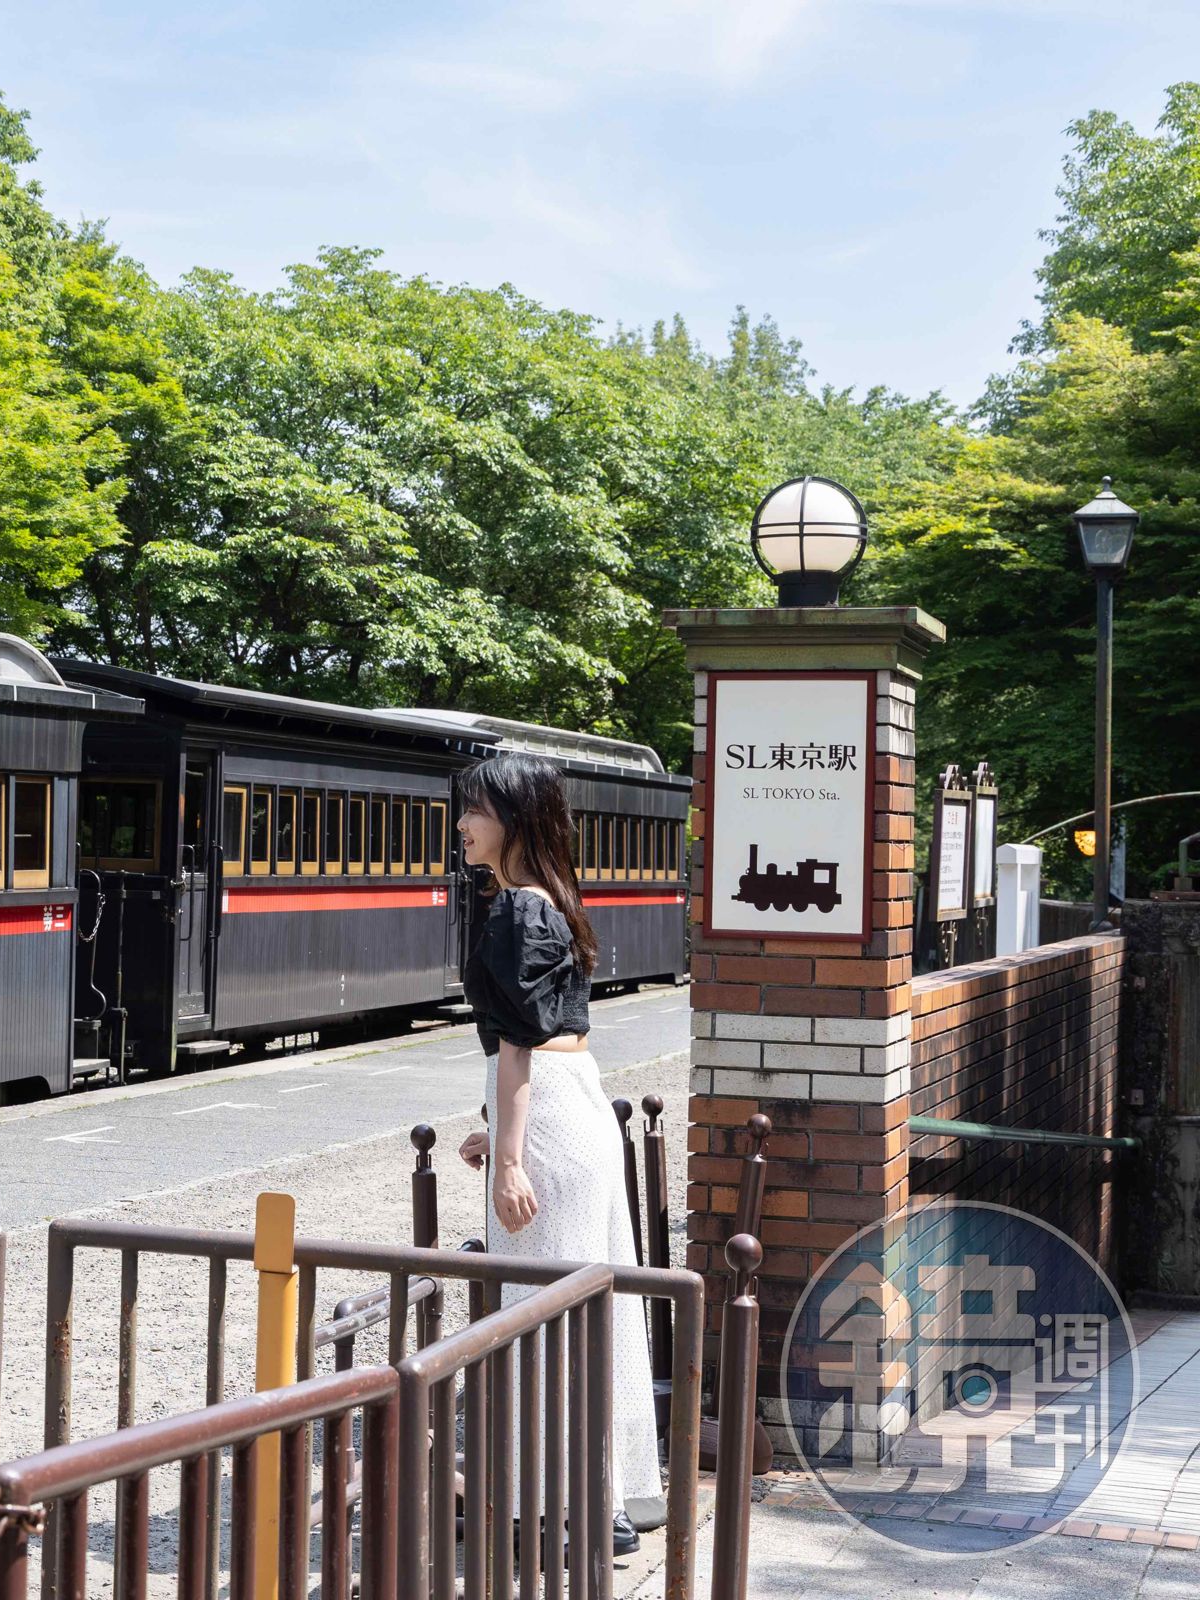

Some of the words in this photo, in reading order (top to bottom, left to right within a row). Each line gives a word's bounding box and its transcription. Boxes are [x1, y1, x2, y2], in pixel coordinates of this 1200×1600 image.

[725, 742, 857, 771] SL東京駅
[742, 787, 759, 799] SL
[762, 787, 815, 800] TOKYO
[818, 788, 840, 801] Sta.
